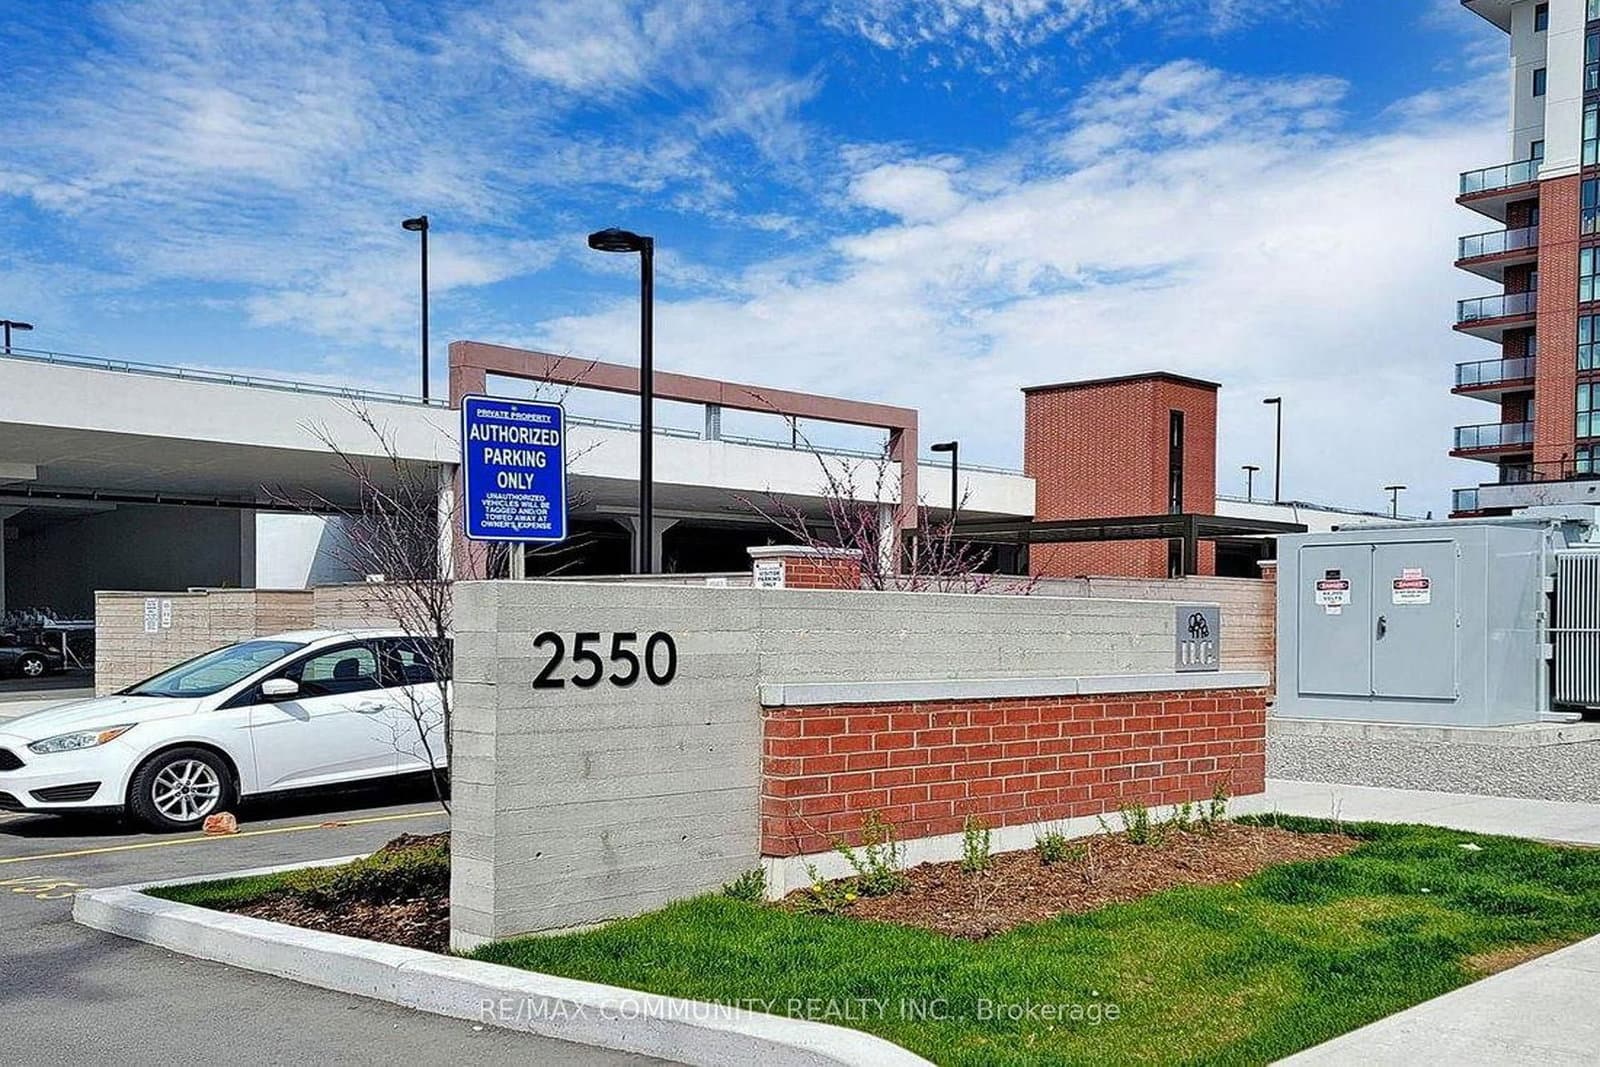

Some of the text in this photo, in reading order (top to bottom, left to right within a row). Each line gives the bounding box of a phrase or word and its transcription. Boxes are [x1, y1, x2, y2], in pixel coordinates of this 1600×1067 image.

[477, 408, 552, 423] PRIVATE PROPERTY
[470, 423, 560, 446] AUTHORIZED
[484, 447, 546, 467] PARKING
[497, 471, 534, 490] ONLY
[481, 499, 519, 507] VEHICLES
[486, 493, 546, 502] UNAUTHORIZED
[485, 506, 548, 515] TAGGED AND/OR
[485, 513, 513, 521] TOWED
[518, 522, 552, 530] EXPENSE
[532, 631, 677, 689] 2550
